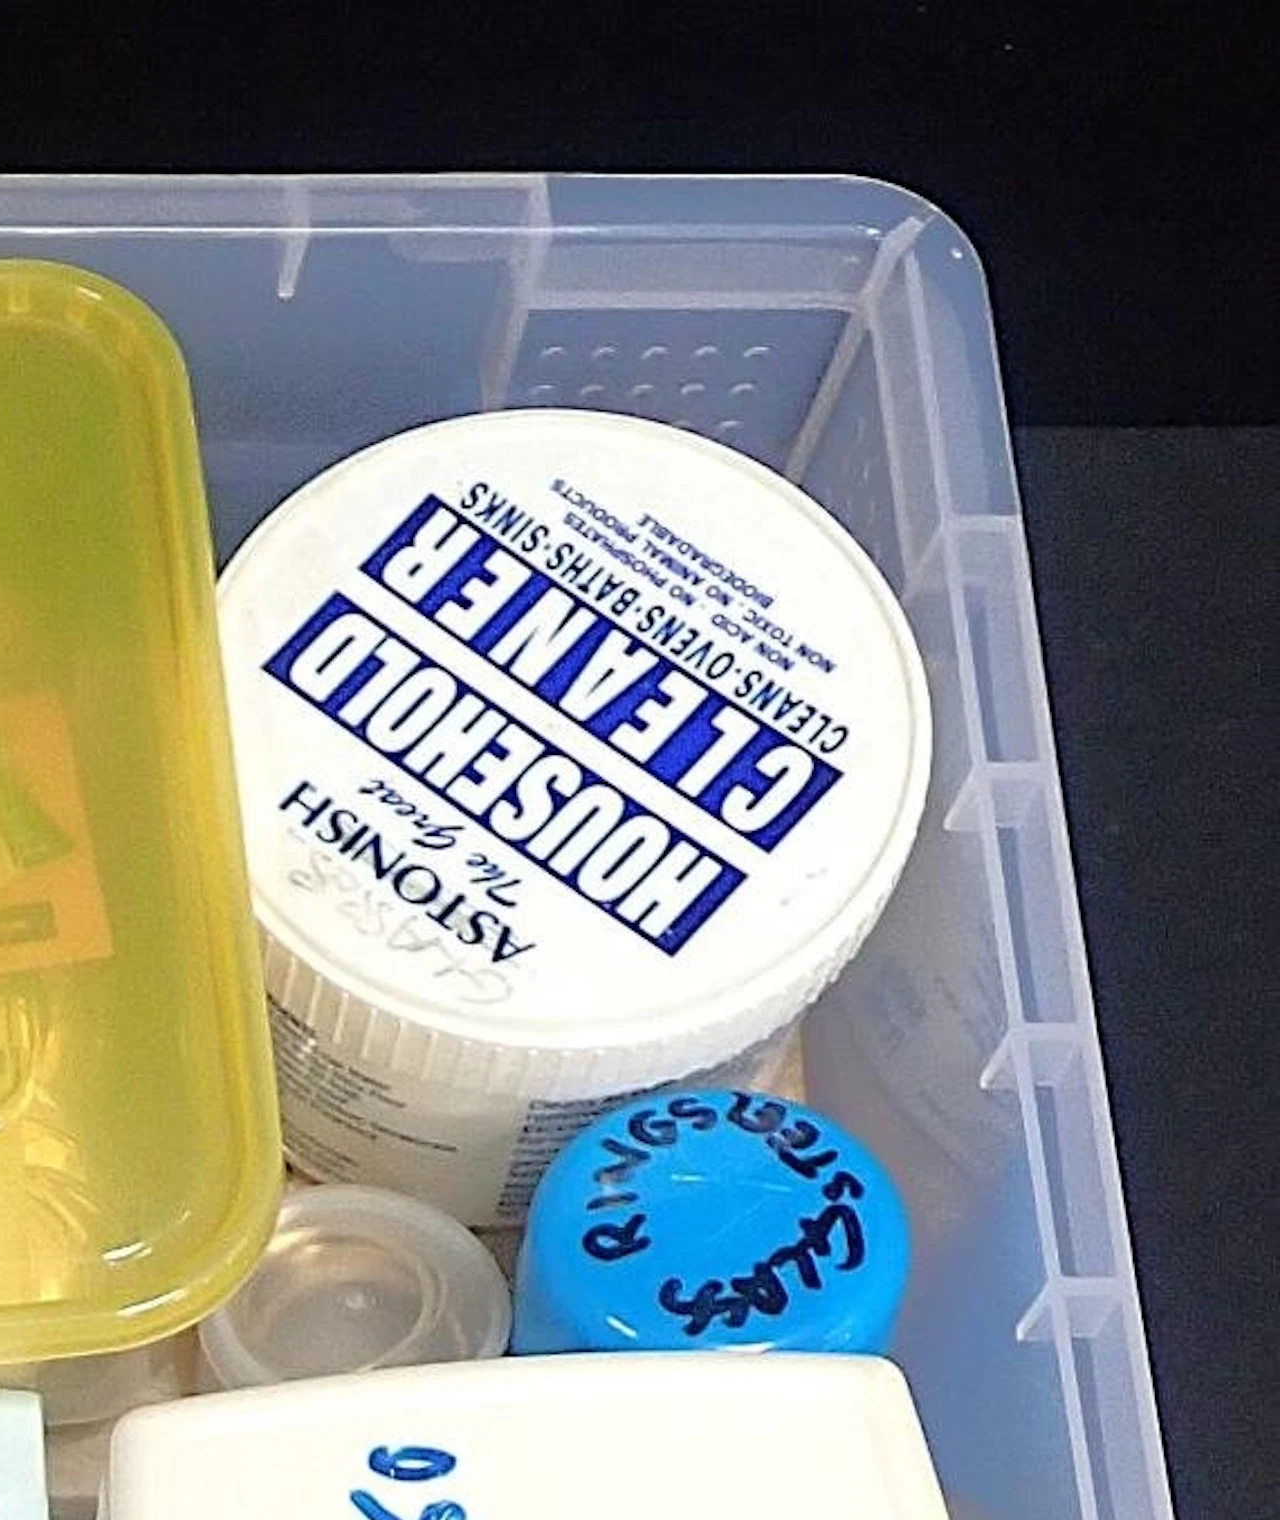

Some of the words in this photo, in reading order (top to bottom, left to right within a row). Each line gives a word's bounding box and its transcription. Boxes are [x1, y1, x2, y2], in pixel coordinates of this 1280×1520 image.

[550, 480, 639, 543] PRODUCTS
[562, 512, 668, 588] PHOSPHATES
[641, 540, 705, 586] ANIMAL
[670, 585, 696, 606] NO
[706, 585, 733, 607] NO
[711, 614, 754, 644] ACID
[754, 642, 795, 671] NON
[381, 500, 815, 834] CLEANER
[795, 644, 837, 674] NON
[286, 603, 723, 940] HOUSEHOLD
[357, 778, 463, 851] Great
[278, 780, 536, 964] ASTONISH
[466, 852, 523, 908] The
